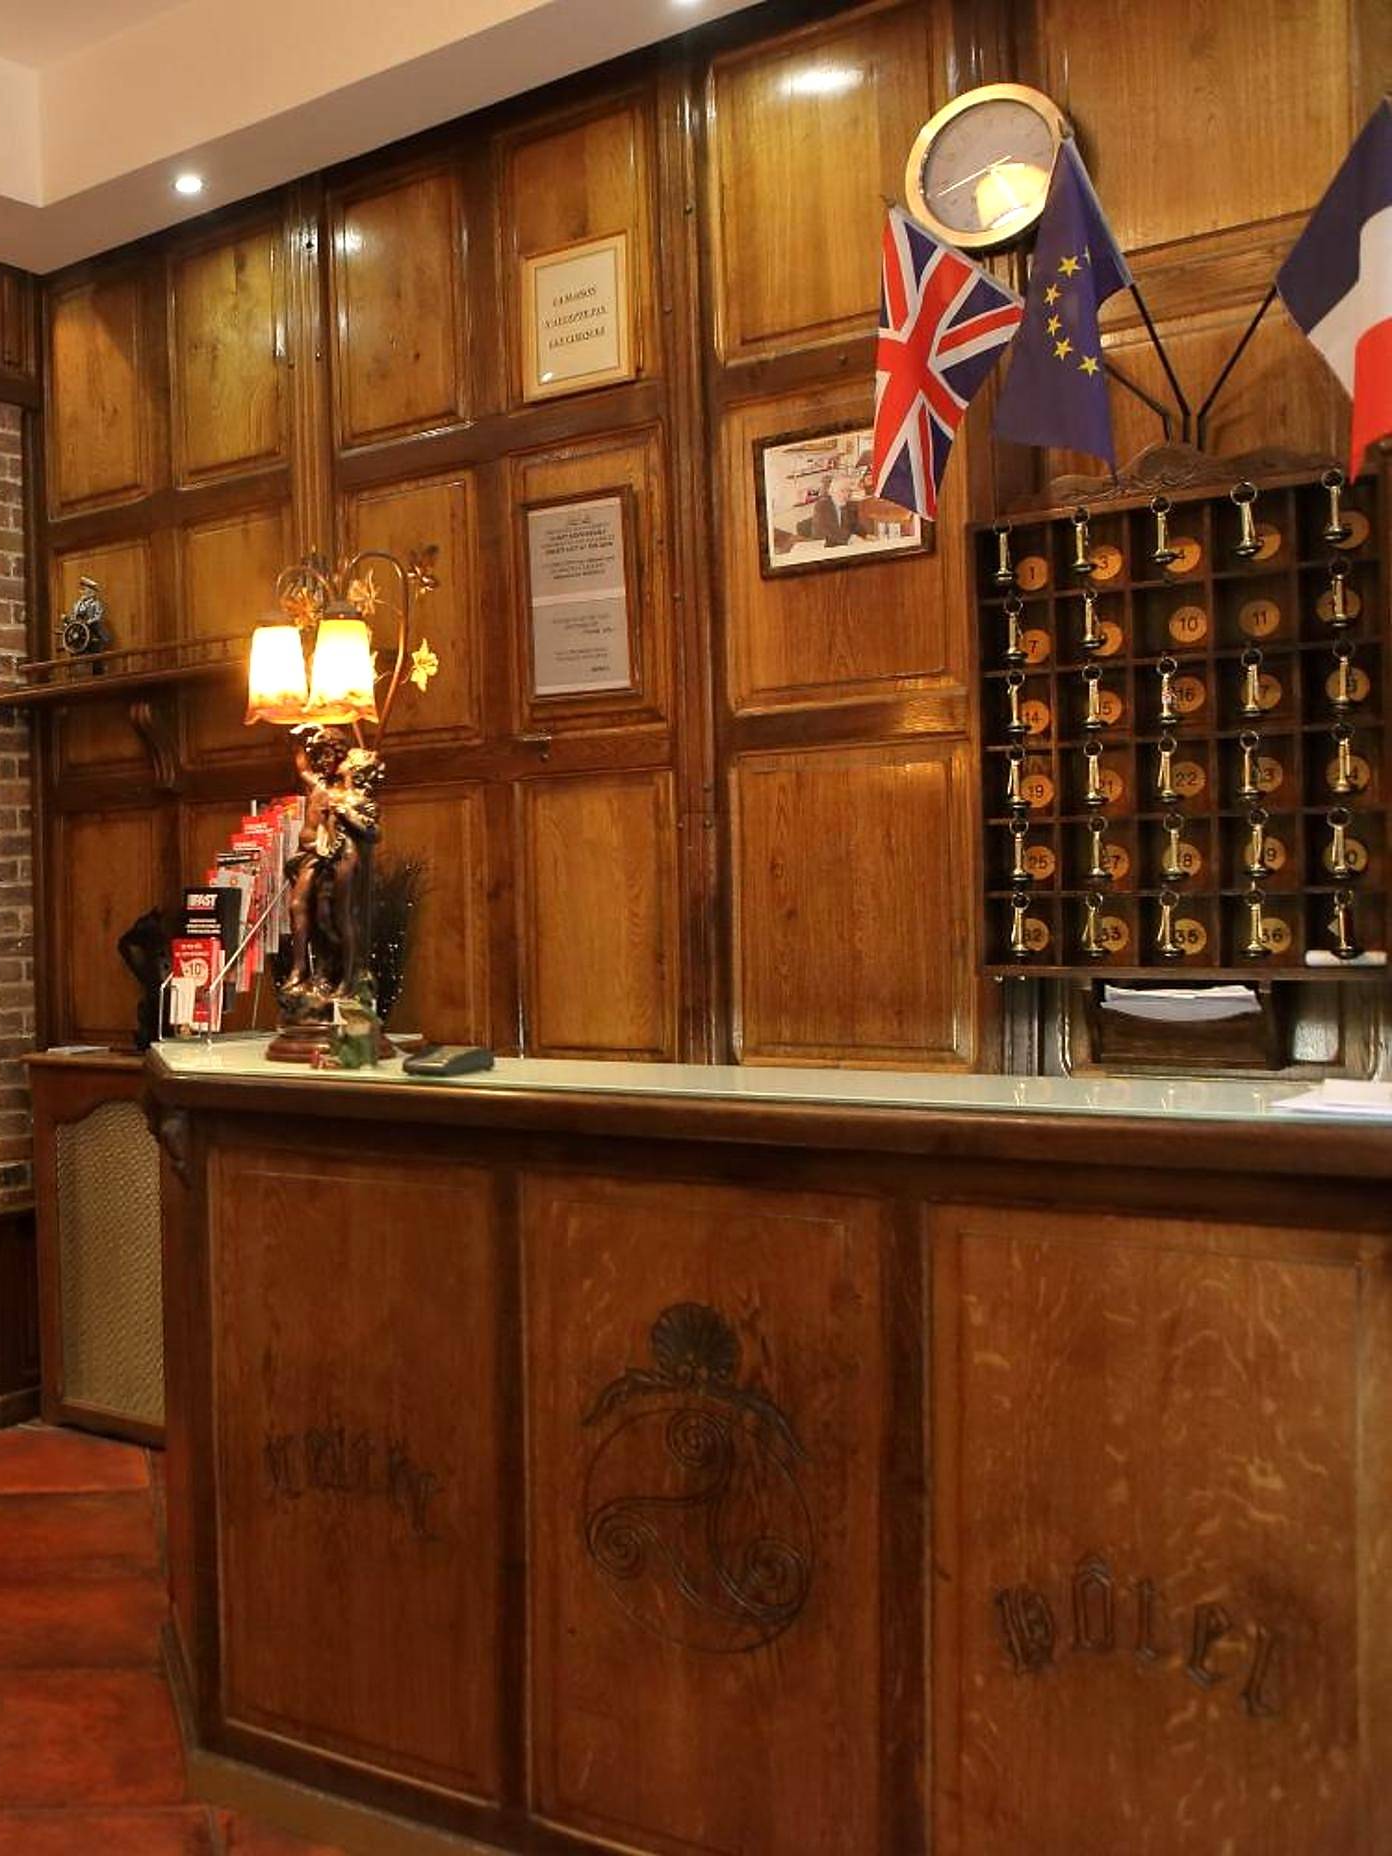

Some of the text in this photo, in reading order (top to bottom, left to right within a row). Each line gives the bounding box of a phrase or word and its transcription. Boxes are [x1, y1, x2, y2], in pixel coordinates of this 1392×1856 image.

[1099, 554, 1108, 569] 3
[1179, 615, 1198, 633] 10
[1252, 609, 1268, 625] 11
[1027, 640, 1039, 654] 7
[1175, 771, 1198, 788] 22
[1025, 784, 1043, 800] 19
